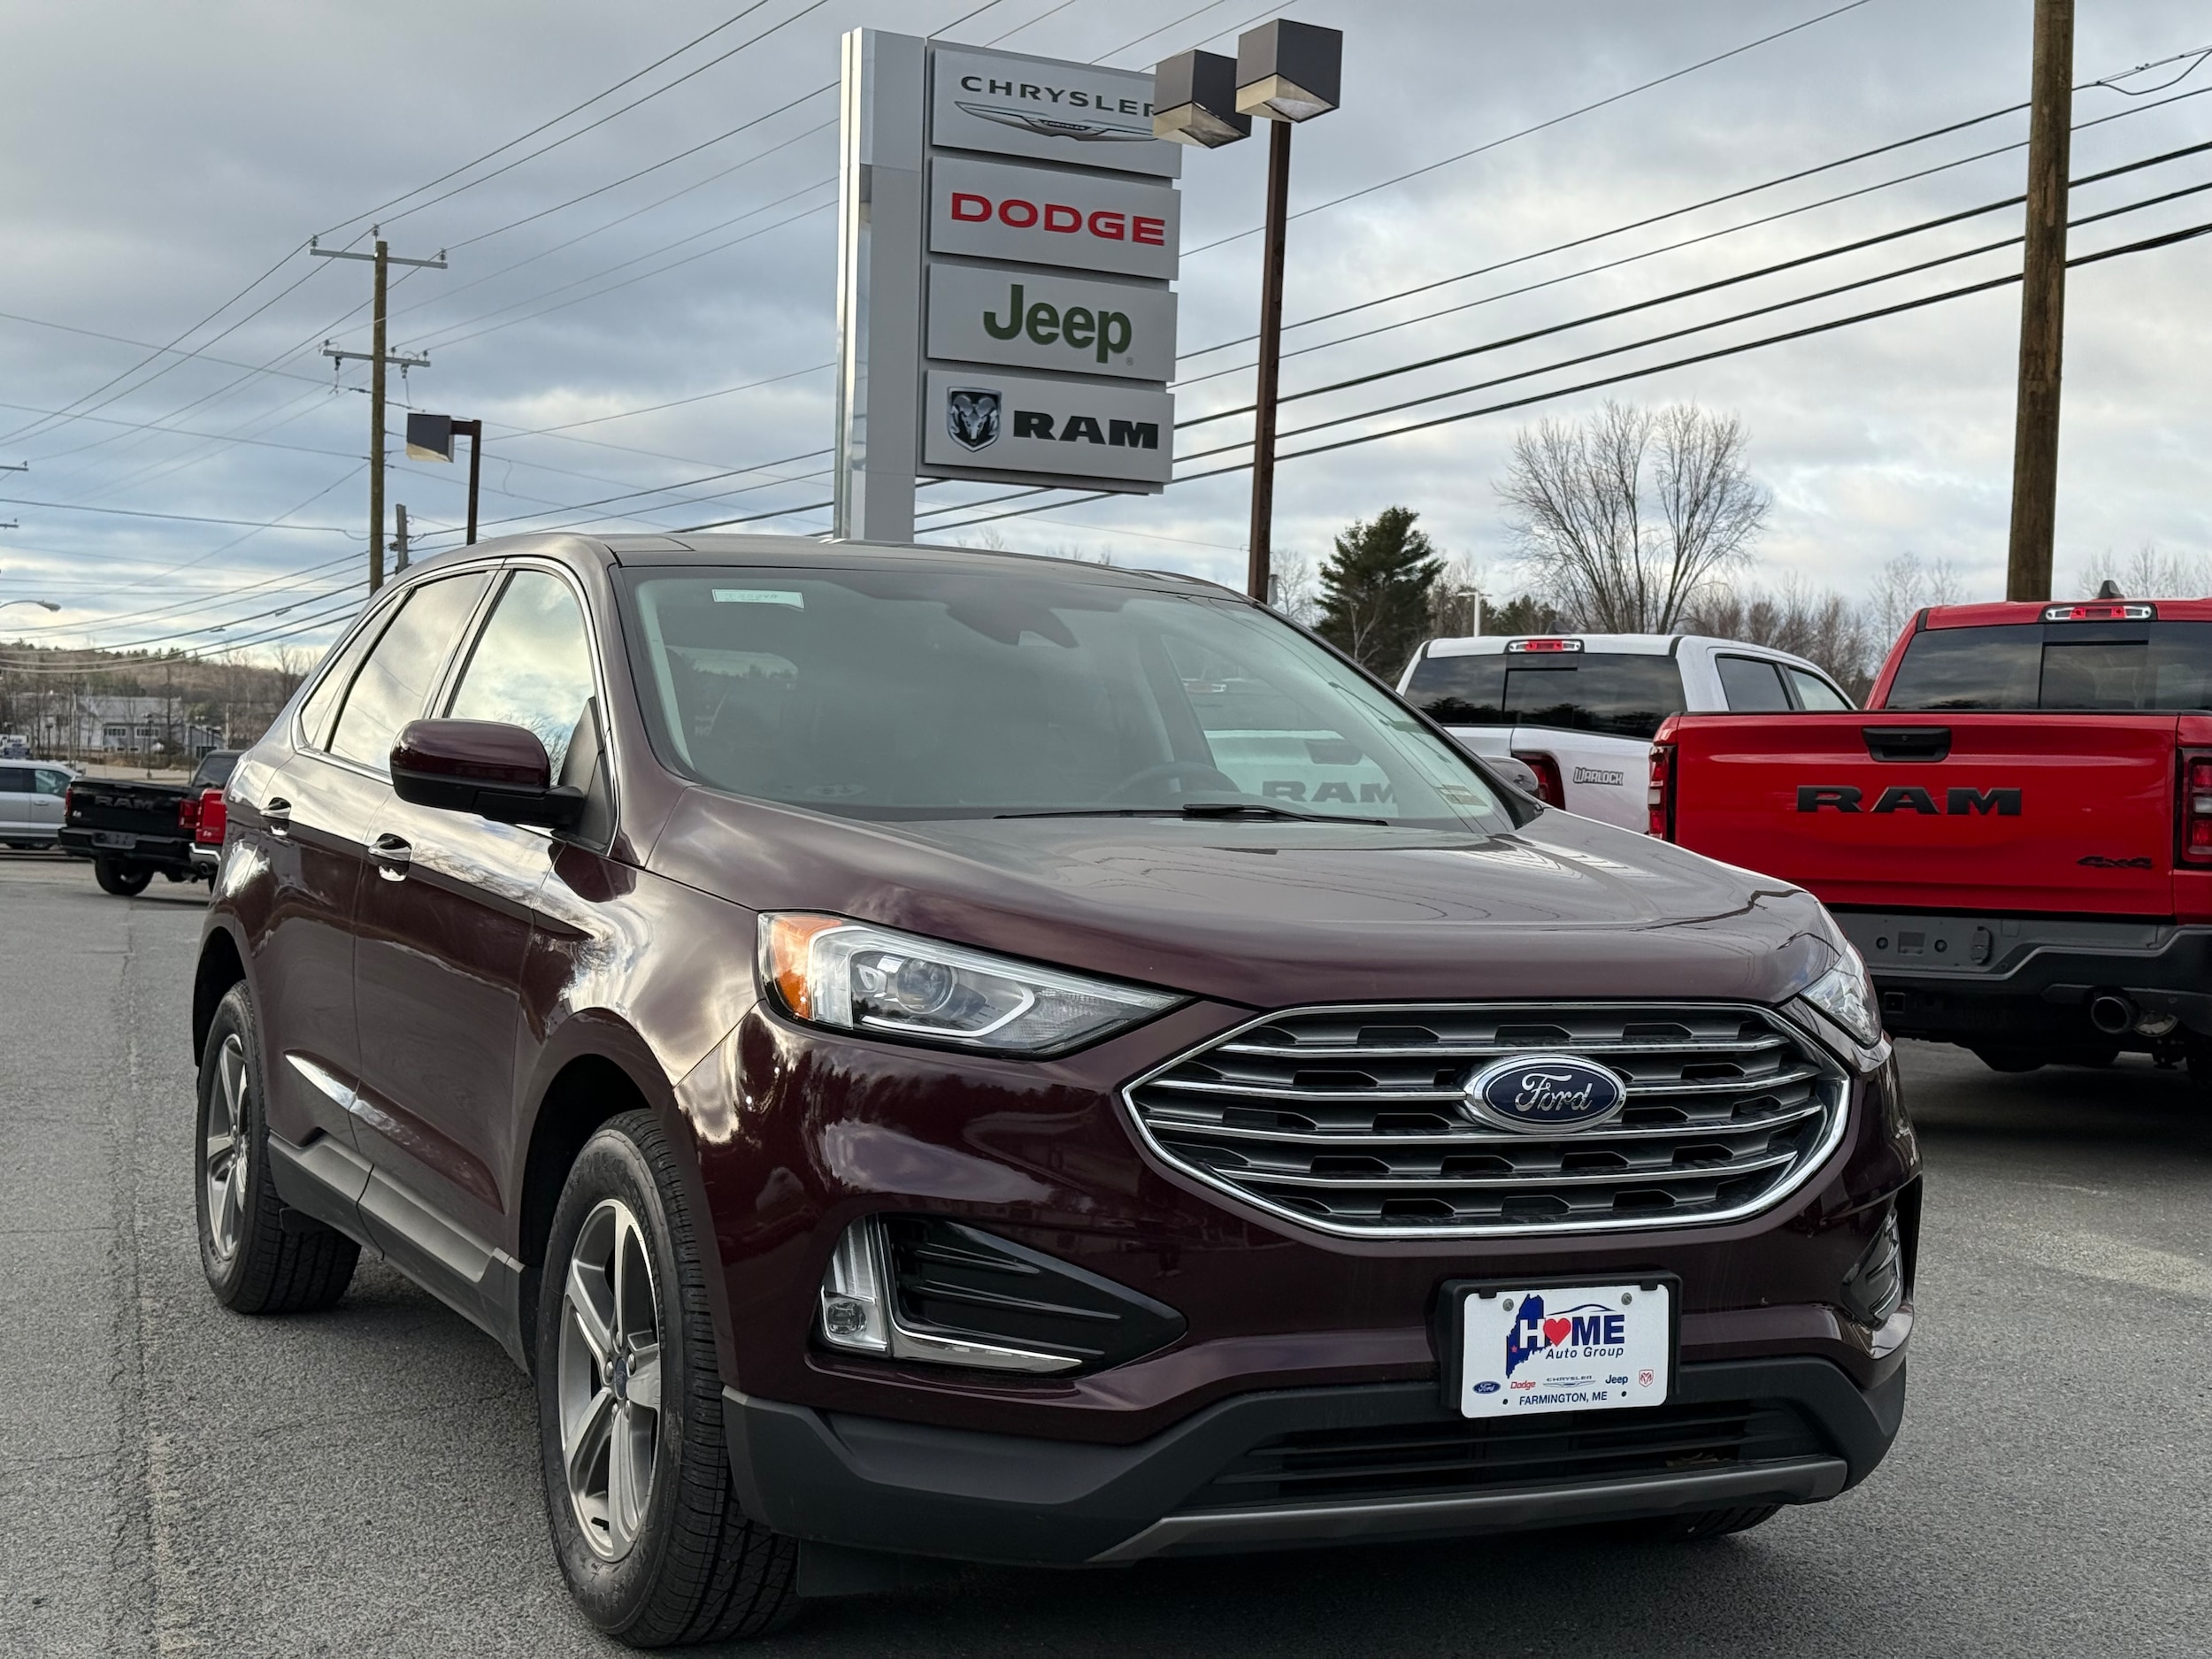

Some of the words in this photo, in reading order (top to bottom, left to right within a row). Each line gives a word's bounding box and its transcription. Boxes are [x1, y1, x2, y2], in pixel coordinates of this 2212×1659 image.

[950, 192, 1165, 247] DODGE
[983, 283, 1133, 364] Jeep
[1012, 410, 1159, 449] RAM
[94, 795, 154, 810] RAM
[1262, 780, 1398, 804] RAM
[1796, 784, 2022, 816] RAM
[1515, 1072, 1593, 1112] Ford
[1546, 1348, 1578, 1360] Auto
[1583, 1346, 1624, 1359] Group
[1509, 1380, 1536, 1391] Dodge
[1605, 1374, 1629, 1386] Jeep
[1519, 1393, 1589, 1406] FARMINGTON,
[1592, 1391, 1609, 1402] ME
